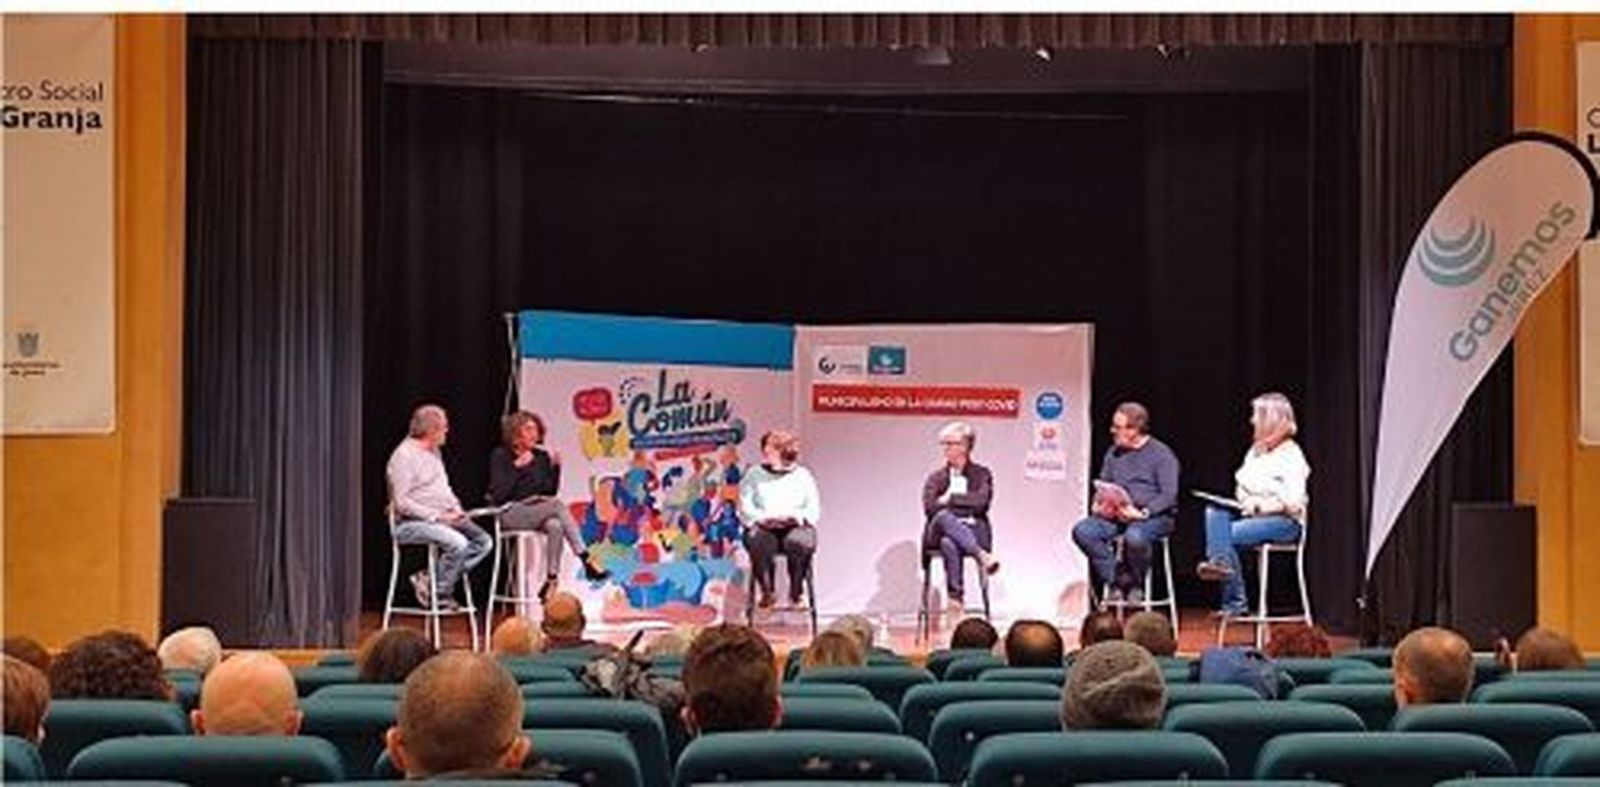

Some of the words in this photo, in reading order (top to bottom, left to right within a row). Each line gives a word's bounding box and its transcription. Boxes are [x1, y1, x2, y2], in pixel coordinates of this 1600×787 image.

[40, 79, 103, 101] Social
[3, 105, 103, 135] Granja
[1449, 200, 1576, 361] Ganemos
[656, 369, 694, 408] La
[628, 391, 731, 436] Común
